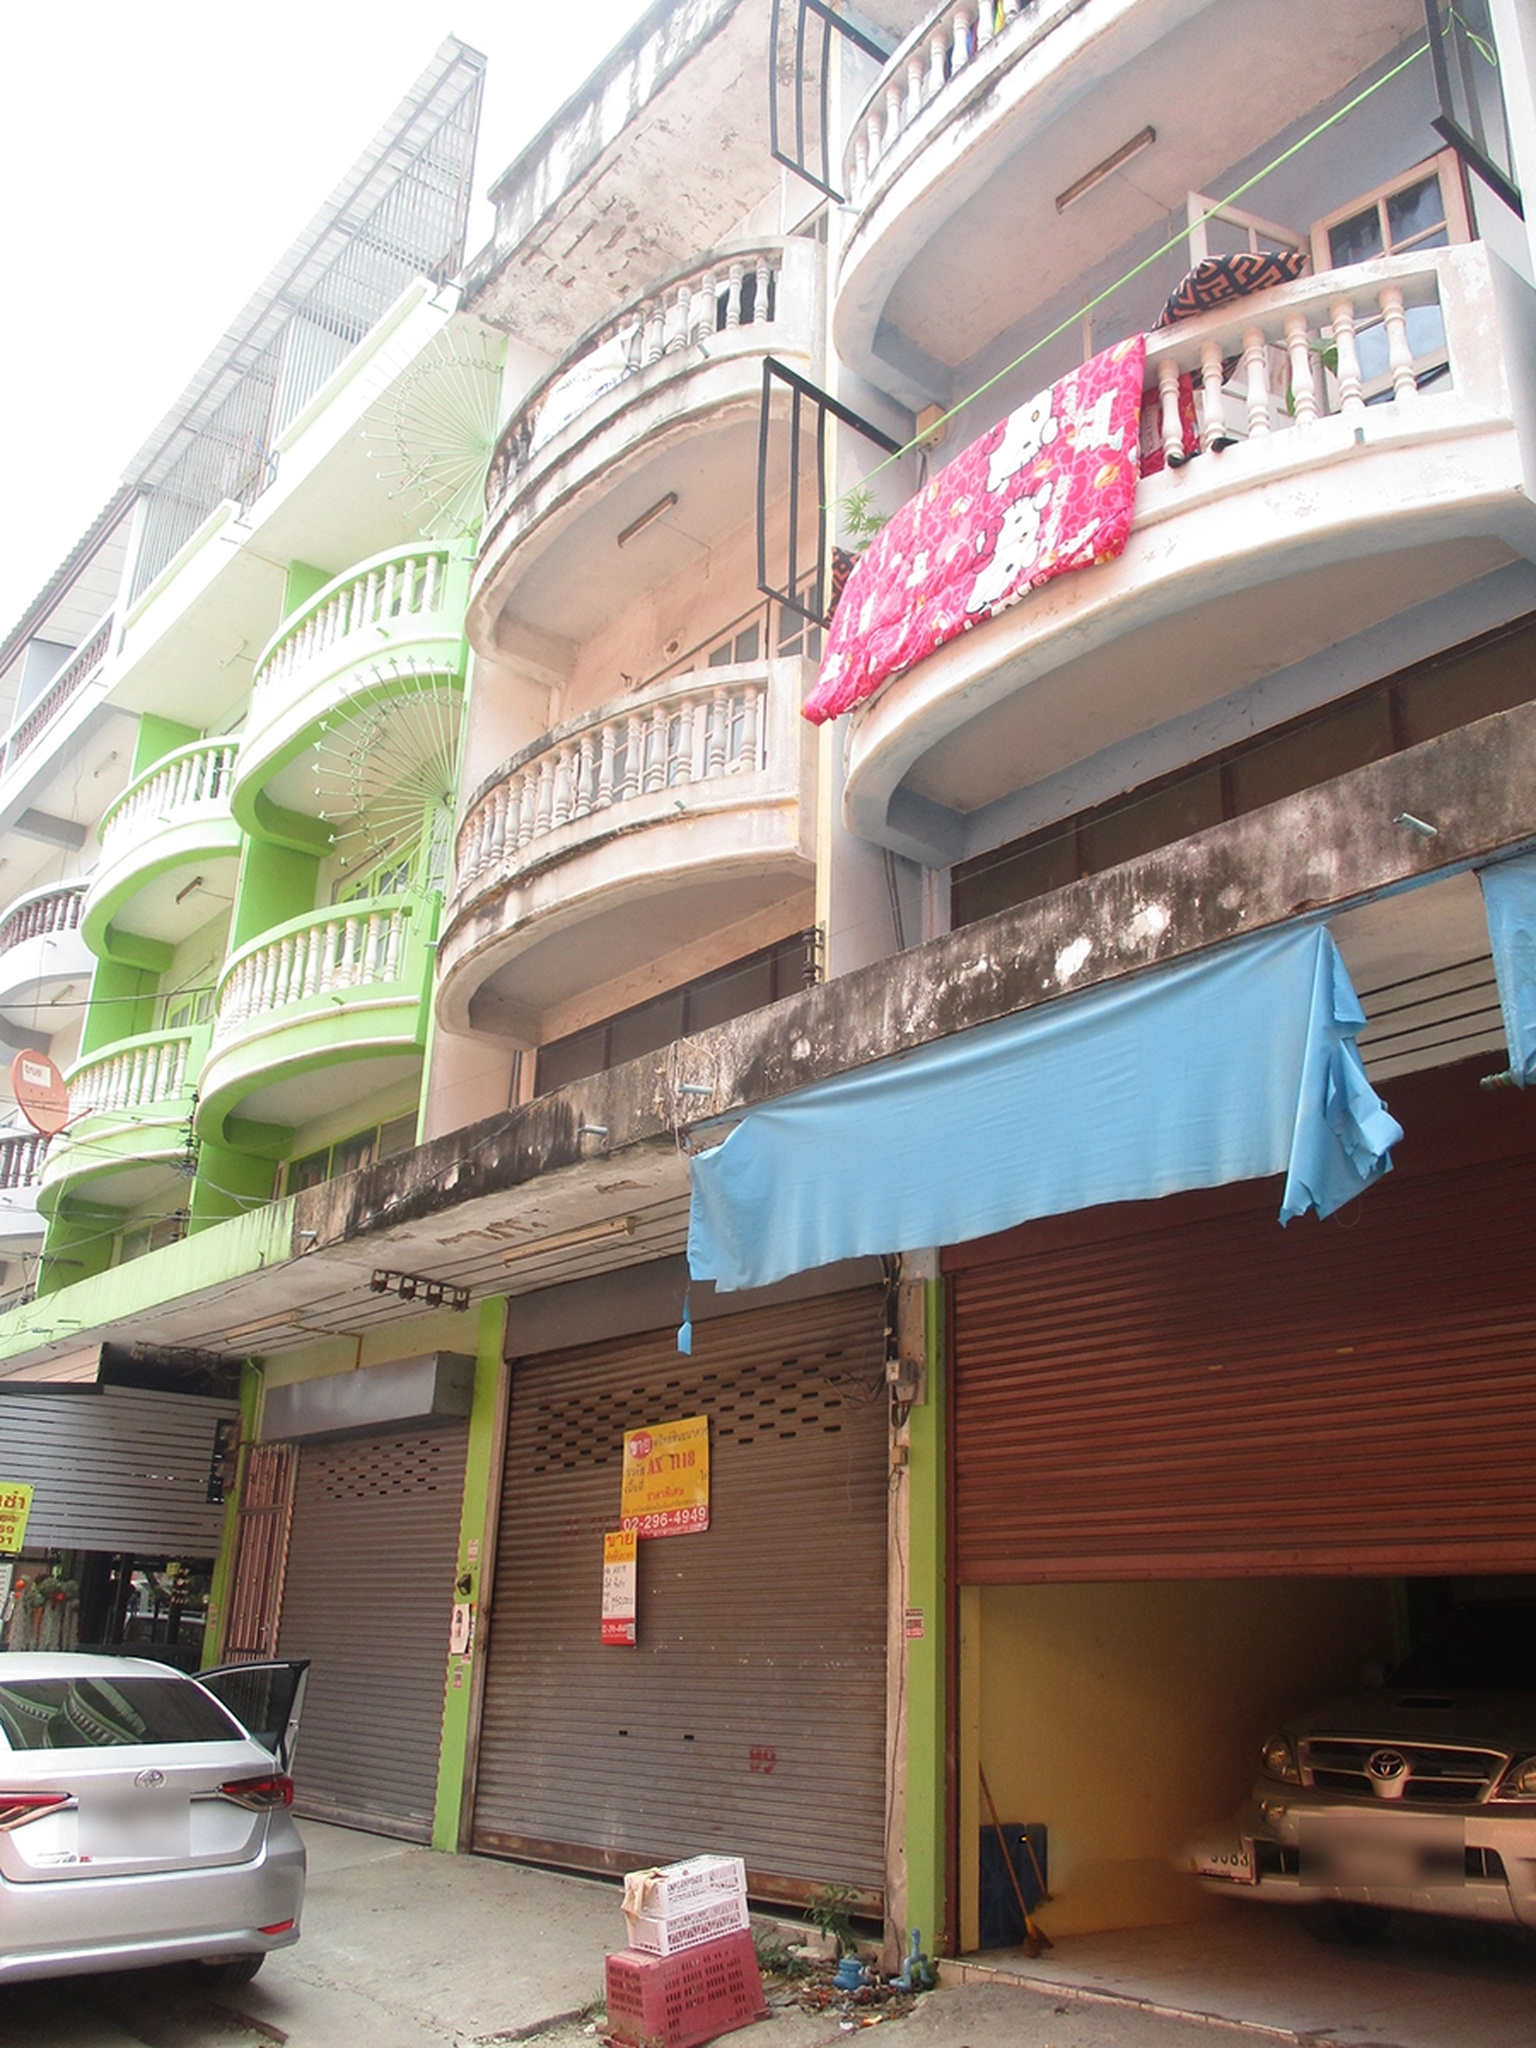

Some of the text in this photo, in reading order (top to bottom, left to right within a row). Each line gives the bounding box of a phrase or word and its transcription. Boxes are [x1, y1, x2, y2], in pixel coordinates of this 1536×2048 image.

[628, 1437, 653, 1457] ขาย
[622, 1505, 706, 1533] 02-296-4949
[606, 1532, 635, 1548] ขาย
